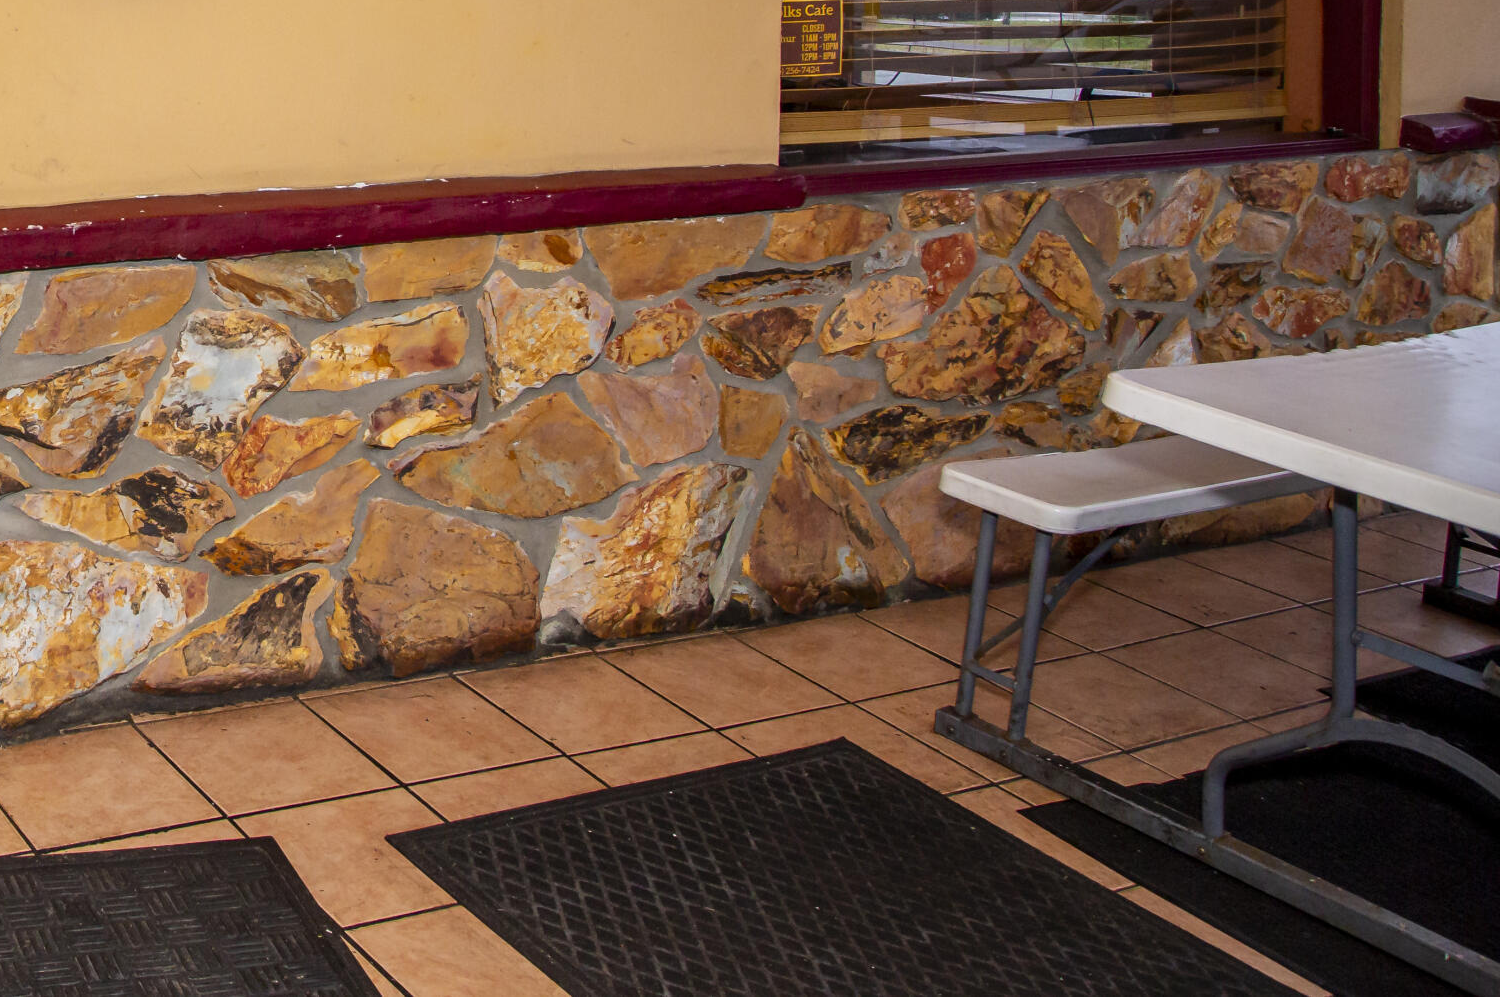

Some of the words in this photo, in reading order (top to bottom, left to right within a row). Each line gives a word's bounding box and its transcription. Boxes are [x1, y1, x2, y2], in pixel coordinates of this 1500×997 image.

[781, 5, 802, 18] lks
[804, 4, 834, 17] Cafe
[802, 24, 825, 33] CLOSED
[801, 34, 819, 43] 11AM
[823, 33, 837, 42] 9PM
[801, 43, 818, 52] 12PM
[801, 52, 818, 61] 12PM
[785, 66, 821, 75] 256-7424
